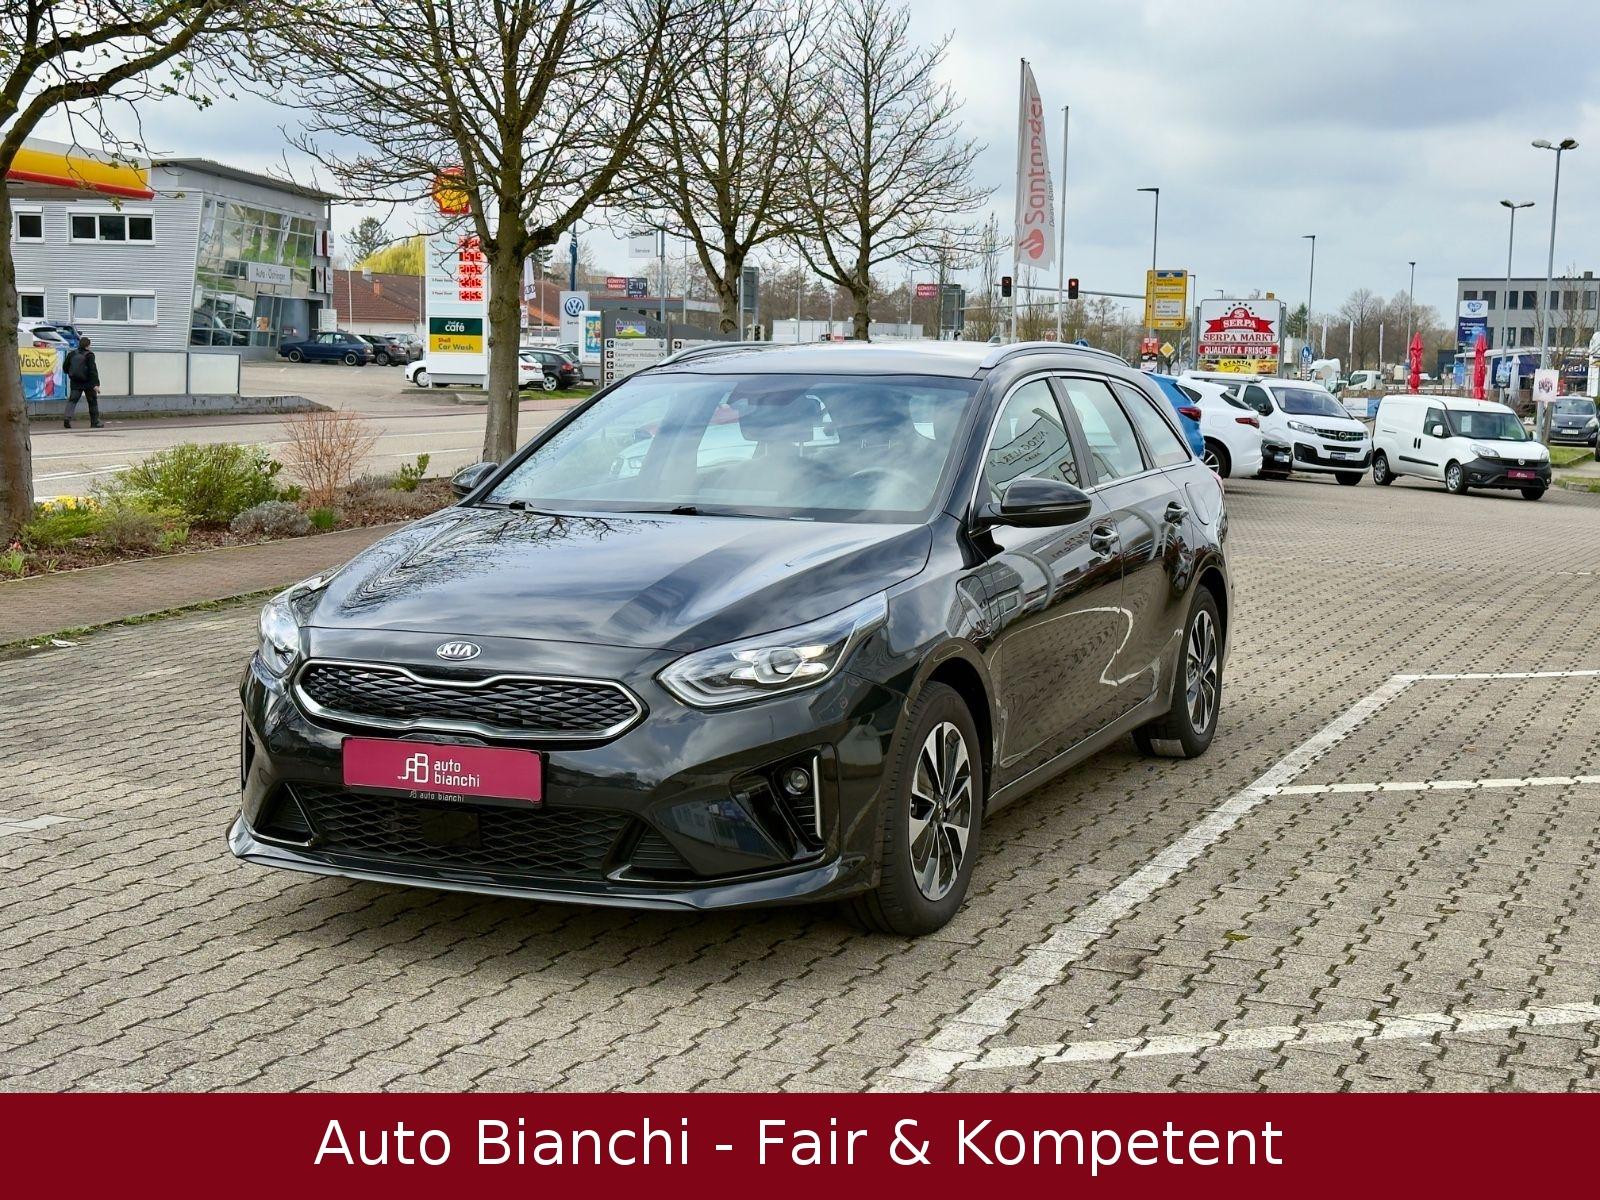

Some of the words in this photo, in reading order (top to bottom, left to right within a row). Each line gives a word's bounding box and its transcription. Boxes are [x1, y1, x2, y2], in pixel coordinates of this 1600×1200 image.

[1024, 96, 1046, 225] Santander
[444, 321, 465, 332] café
[1222, 319, 1256, 329] SERPA
[1203, 333, 1236, 341] SERPA
[1240, 333, 1275, 341] MARKT
[1204, 345, 1236, 355] QUALITÄT
[1236, 346, 1242, 354] &
[1244, 346, 1272, 355] FRISCHE
[441, 643, 473, 657] KIA
[433, 758, 461, 772] auto
[434, 771, 480, 788] bianchi
[419, 792, 435, 801] auto
[438, 792, 465, 803] bianchi
